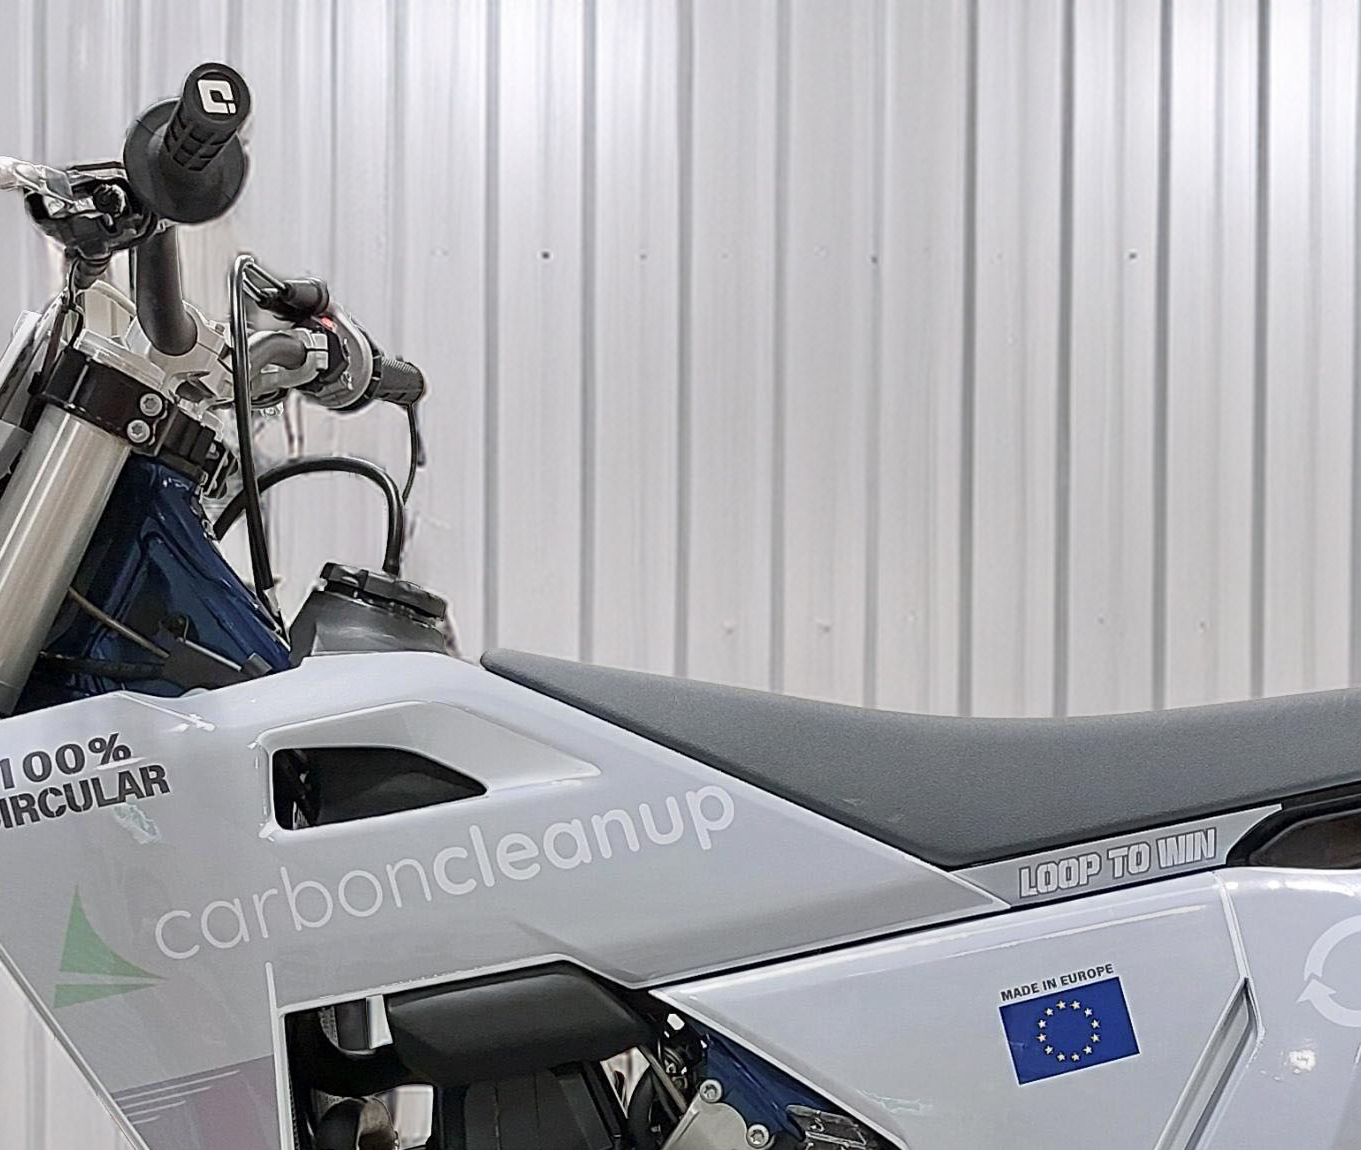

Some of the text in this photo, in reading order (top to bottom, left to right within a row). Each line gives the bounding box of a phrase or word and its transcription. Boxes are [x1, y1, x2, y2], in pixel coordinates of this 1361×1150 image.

[155, 783, 736, 961] carboncleanup
[1019, 827, 1218, 898] LOOP TO WIN
[1001, 963, 1114, 1001] MADE IN EUROPE
